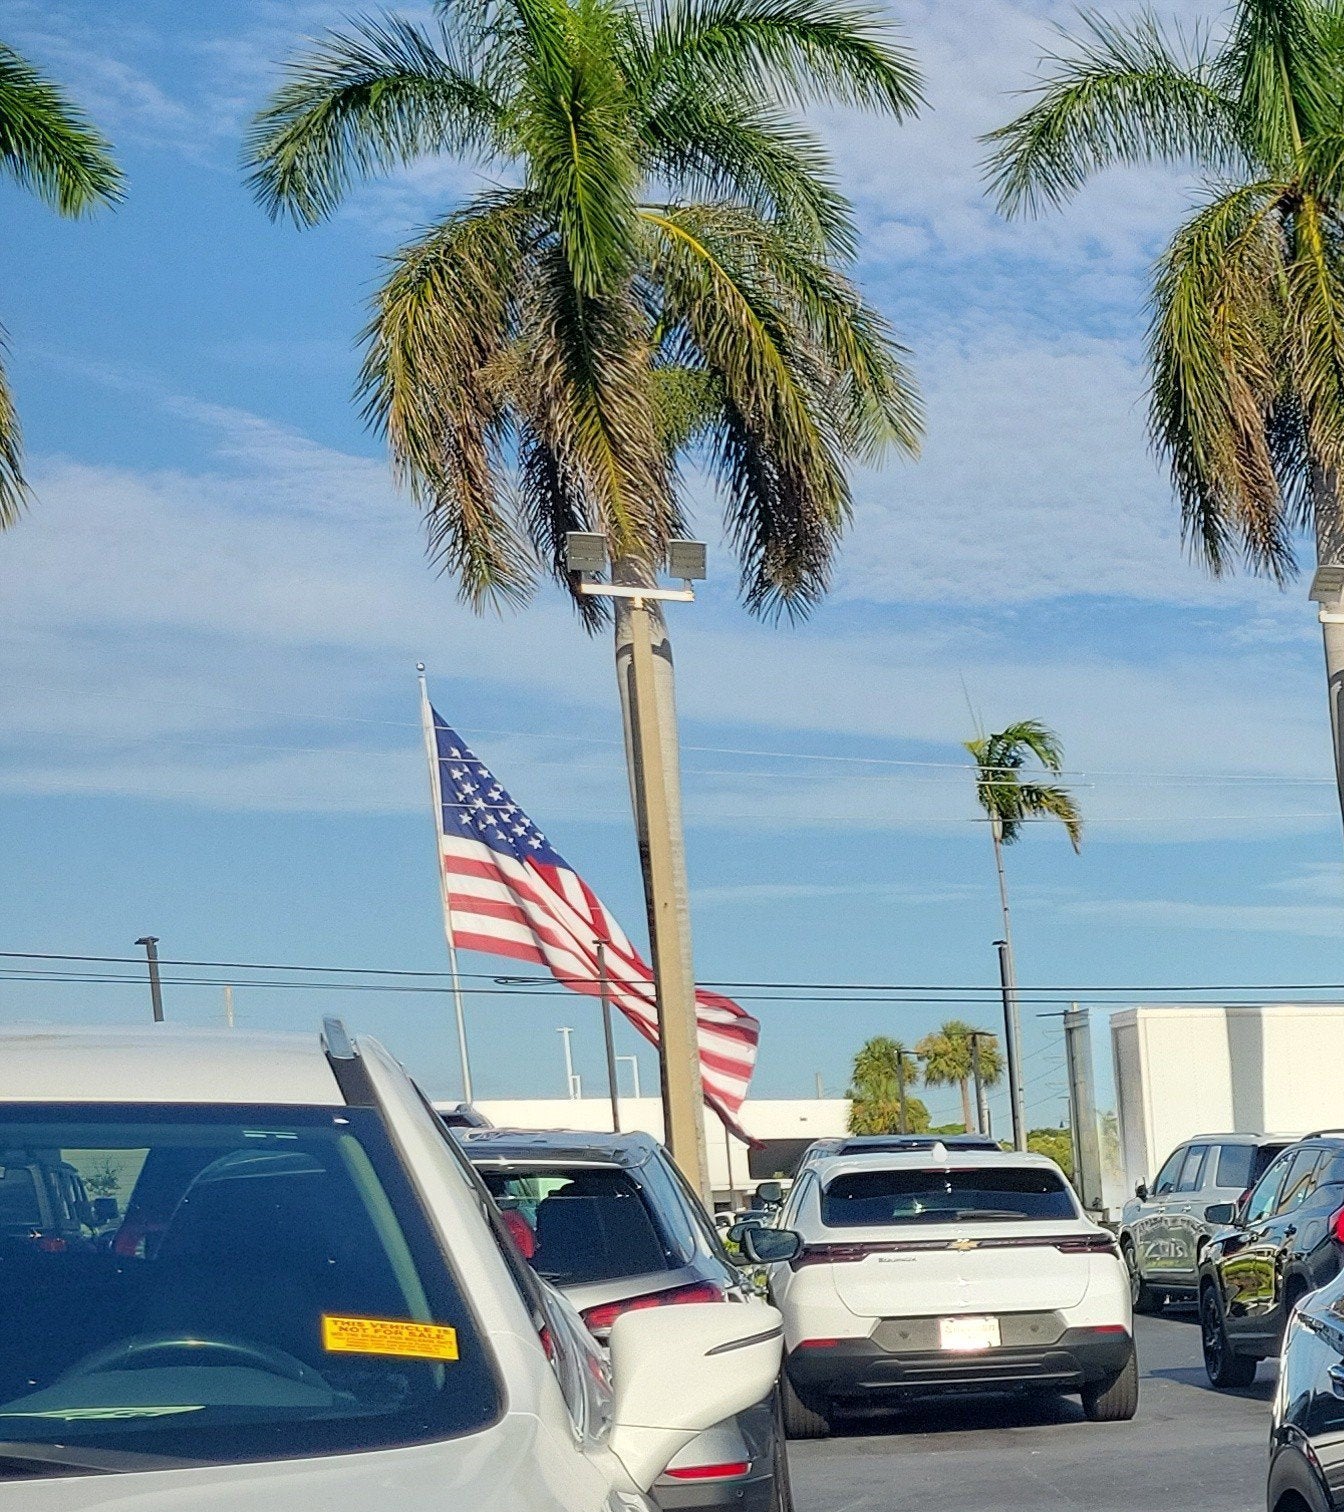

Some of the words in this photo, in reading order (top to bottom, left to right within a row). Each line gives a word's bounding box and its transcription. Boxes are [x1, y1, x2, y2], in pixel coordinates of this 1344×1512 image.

[332, 1319, 365, 1328] THIS
[369, 1322, 433, 1334] VEHICLE
[338, 1326, 369, 1334] NOT
[374, 1328, 404, 1336] FOR
[408, 1332, 445, 1340] SALE
